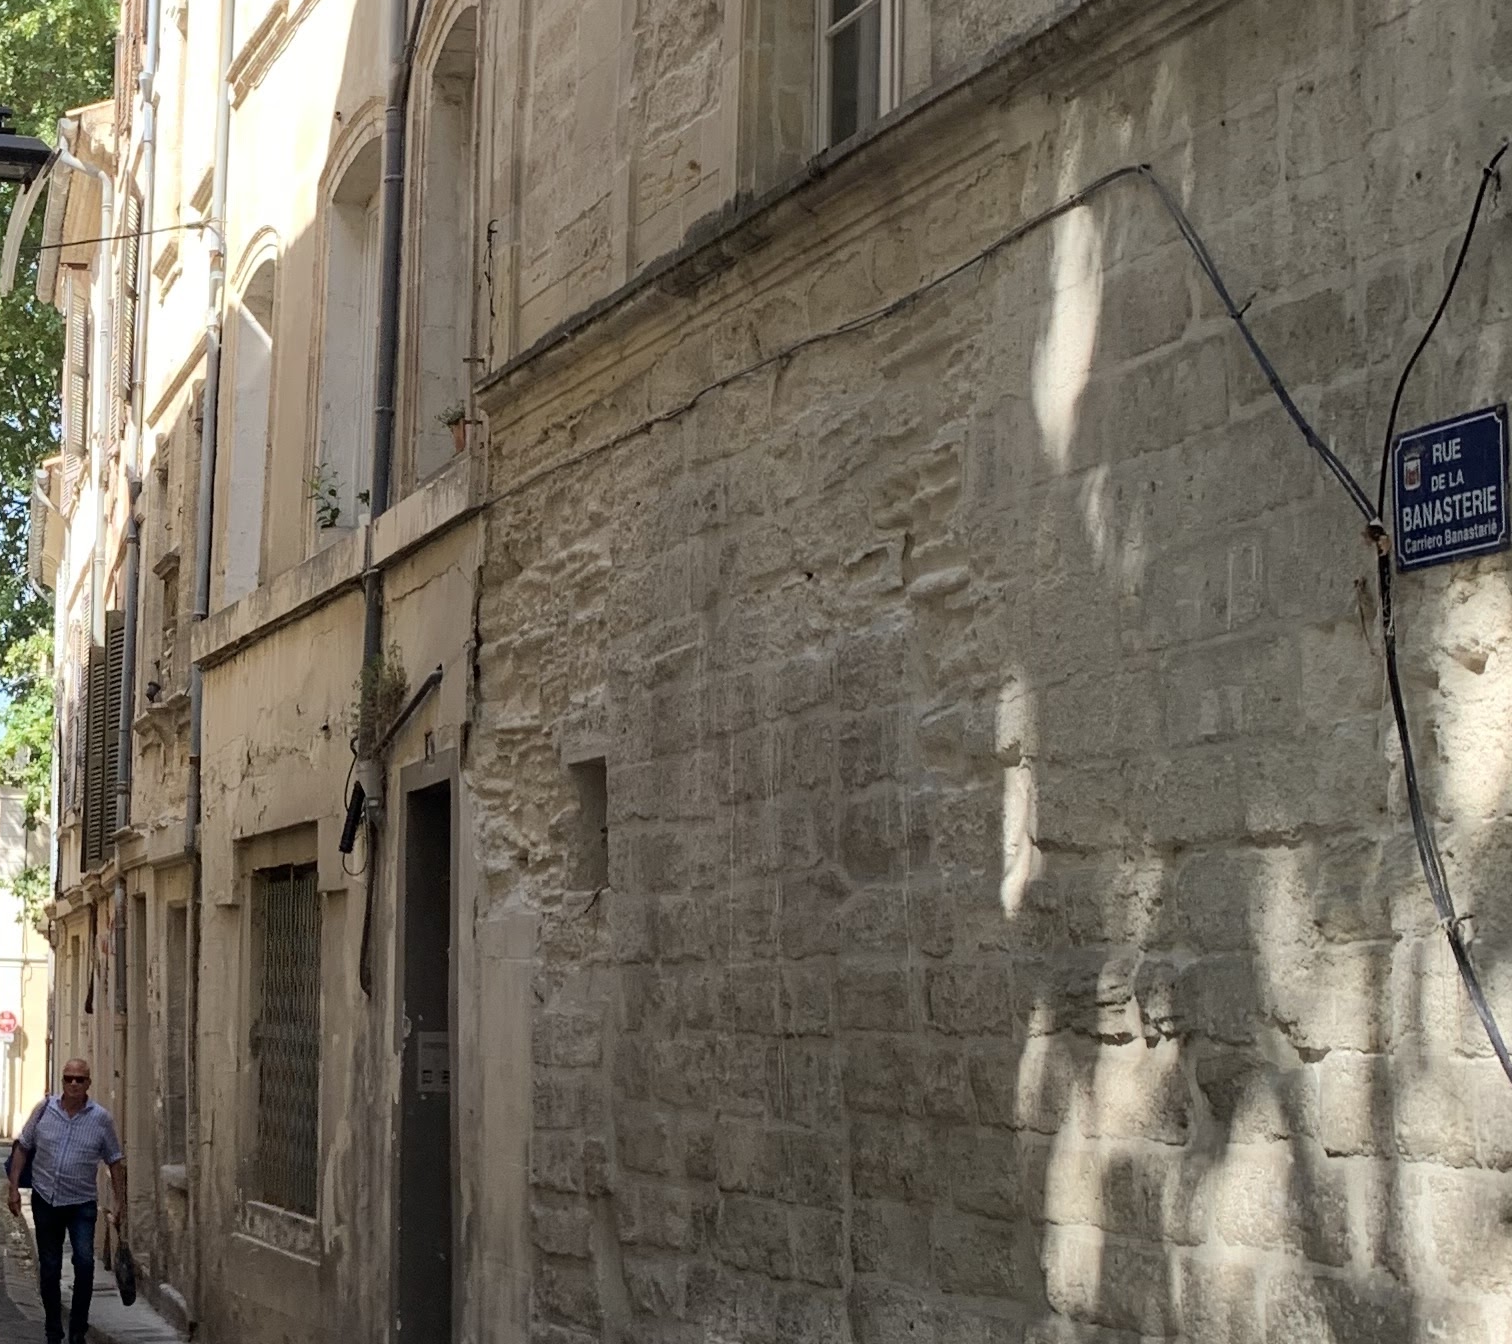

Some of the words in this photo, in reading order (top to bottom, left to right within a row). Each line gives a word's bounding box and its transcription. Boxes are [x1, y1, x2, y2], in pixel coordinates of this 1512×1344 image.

[1432, 438, 1462, 465] RUE
[1431, 473, 1445, 492] DE
[1448, 469, 1465, 487] LA
[1402, 486, 1497, 532] BANASTERIE
